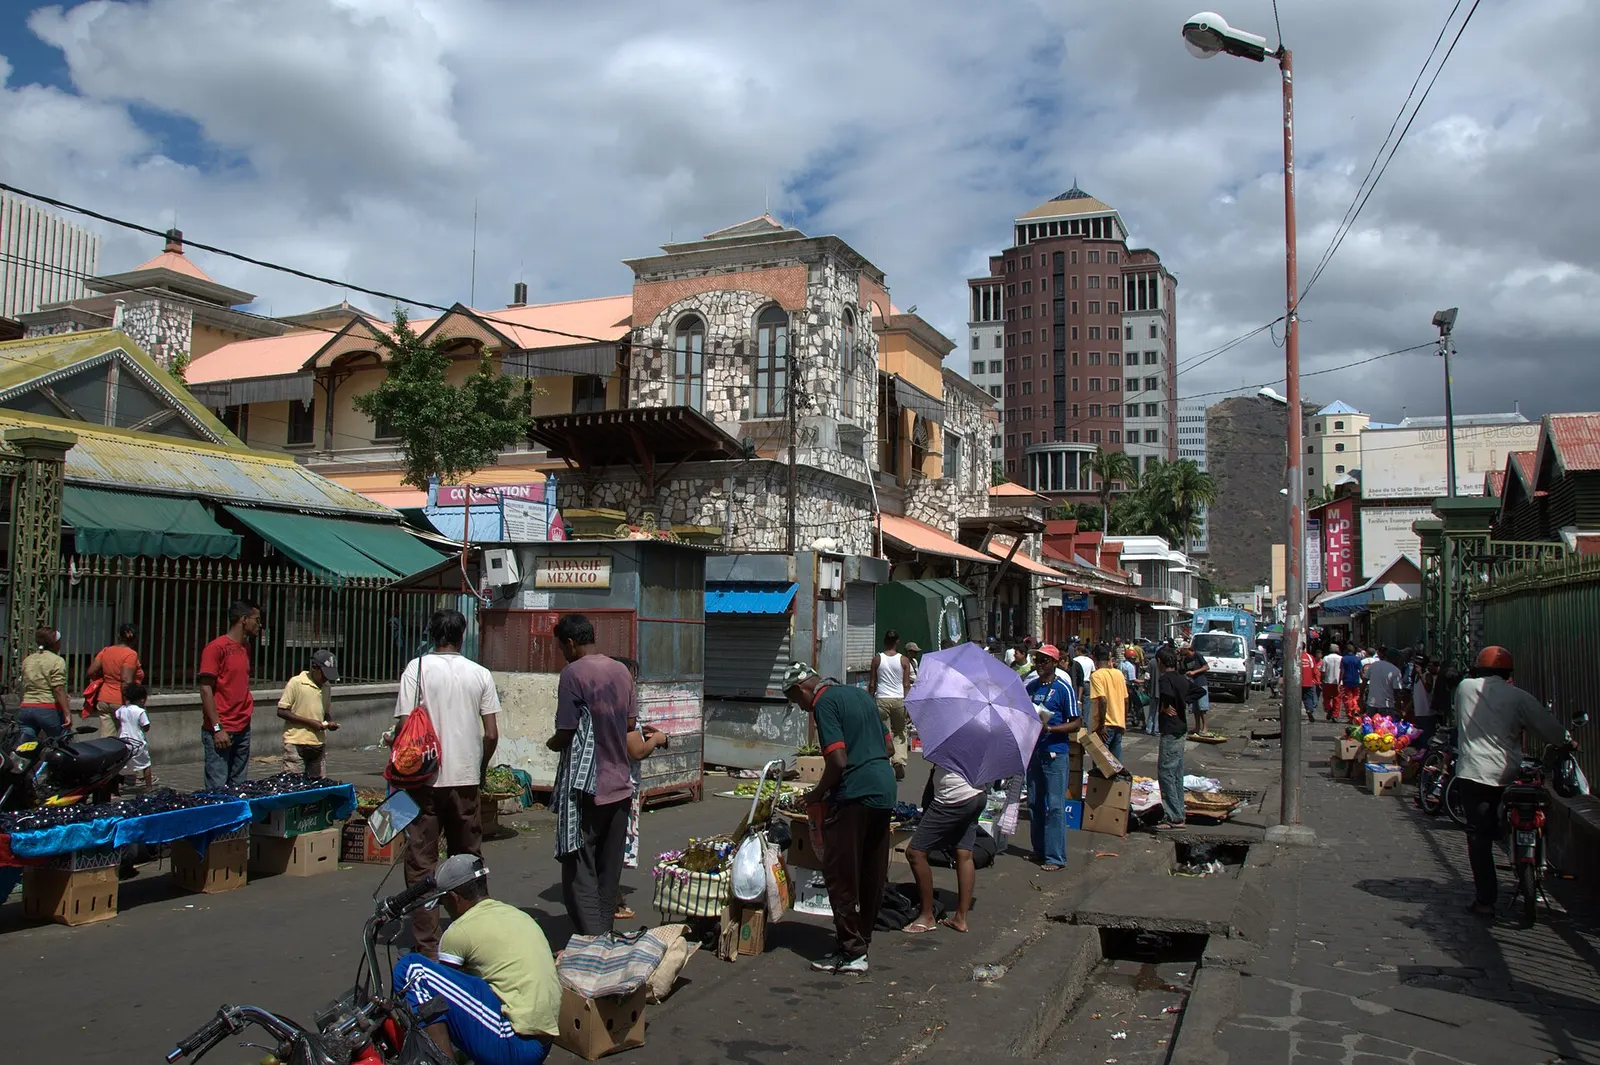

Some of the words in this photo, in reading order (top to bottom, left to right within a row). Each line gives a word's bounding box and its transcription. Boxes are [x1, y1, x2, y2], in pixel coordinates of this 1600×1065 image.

[1419, 428, 1477, 441] MUTI
[1484, 424, 1537, 439] DECO
[1328, 509, 1340, 577] MULTI
[1340, 519, 1352, 587] DECOR
[546, 560, 602, 571] TABAGIE
[547, 572, 597, 583] MEXICO
